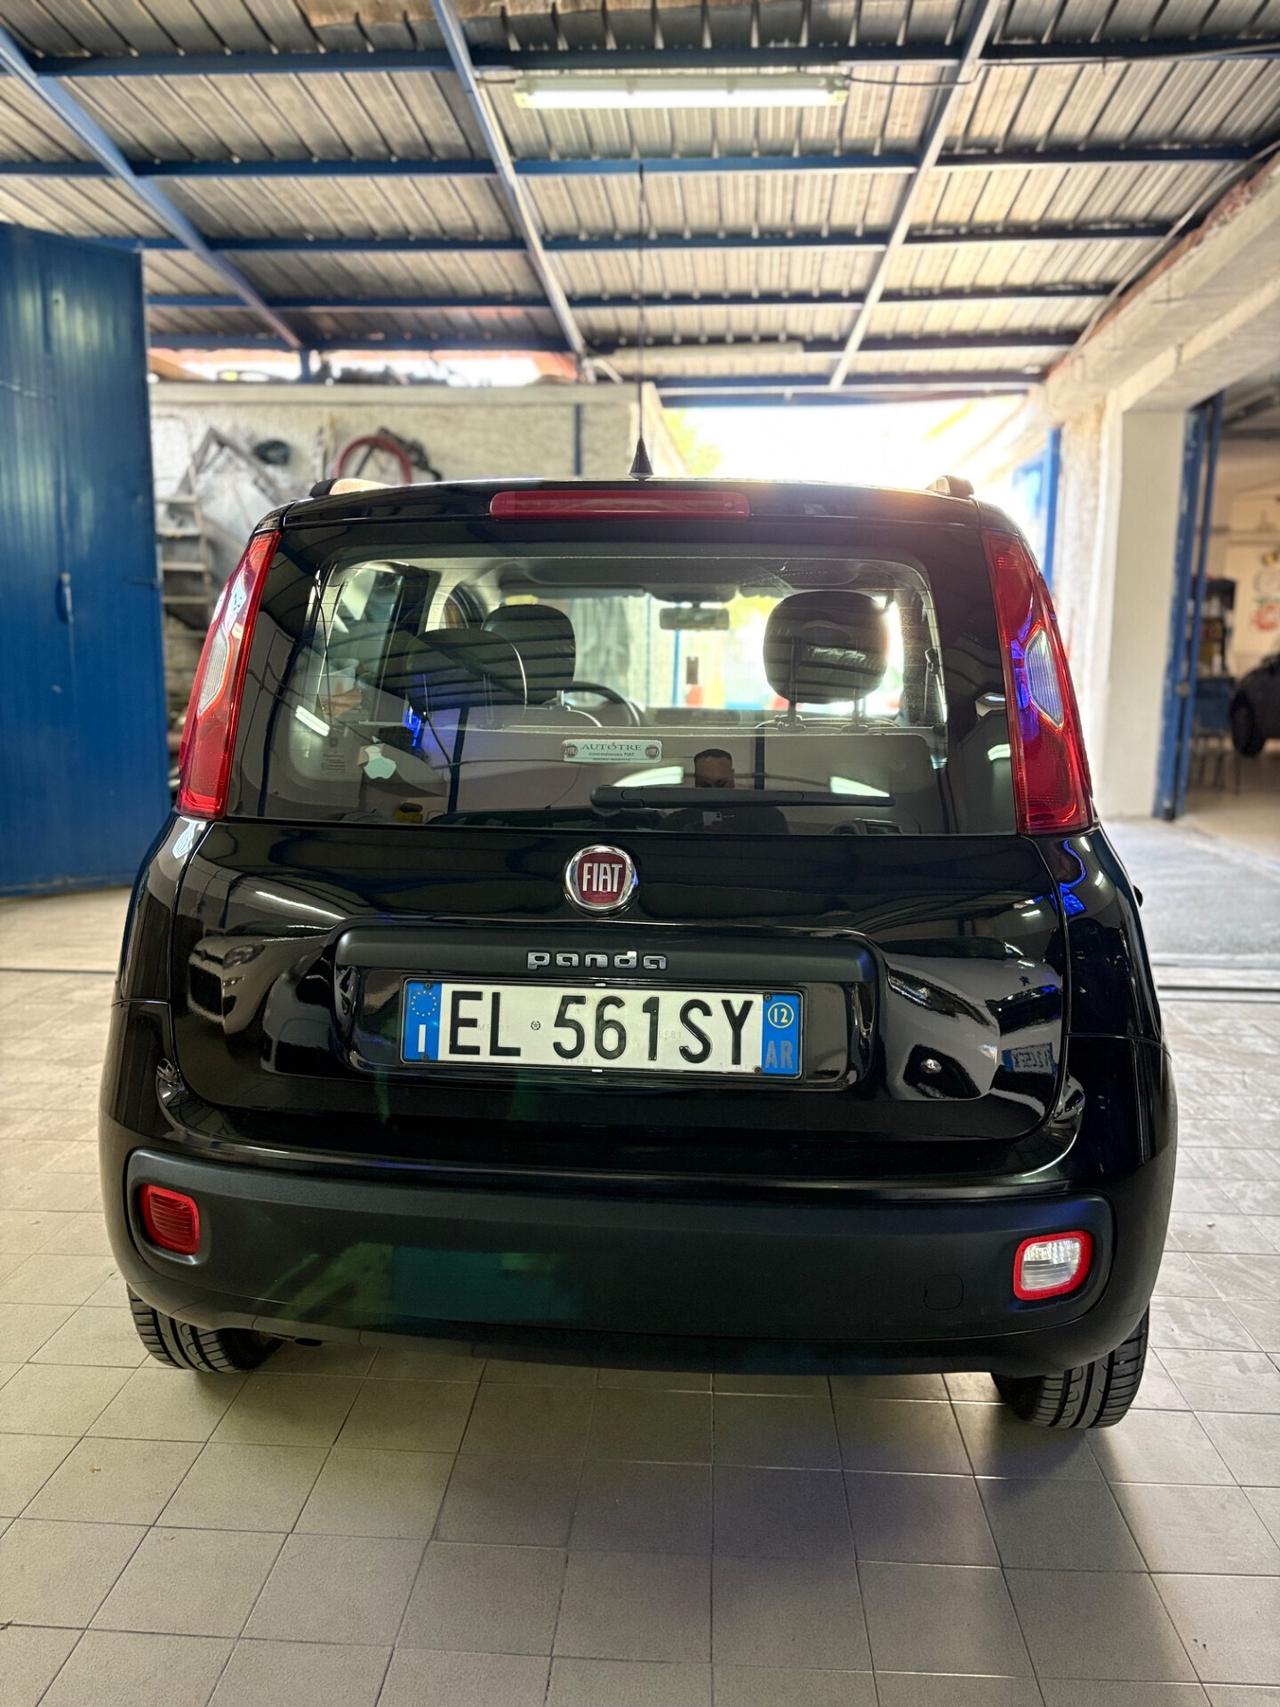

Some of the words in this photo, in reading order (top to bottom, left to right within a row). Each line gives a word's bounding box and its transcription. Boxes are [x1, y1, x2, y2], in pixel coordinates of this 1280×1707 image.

[582, 862, 622, 893] FIAT
[527, 951, 667, 970] panda
[449, 991, 521, 1057] EL
[772, 1008, 788, 1024] 12
[765, 1040, 793, 1070] AR
